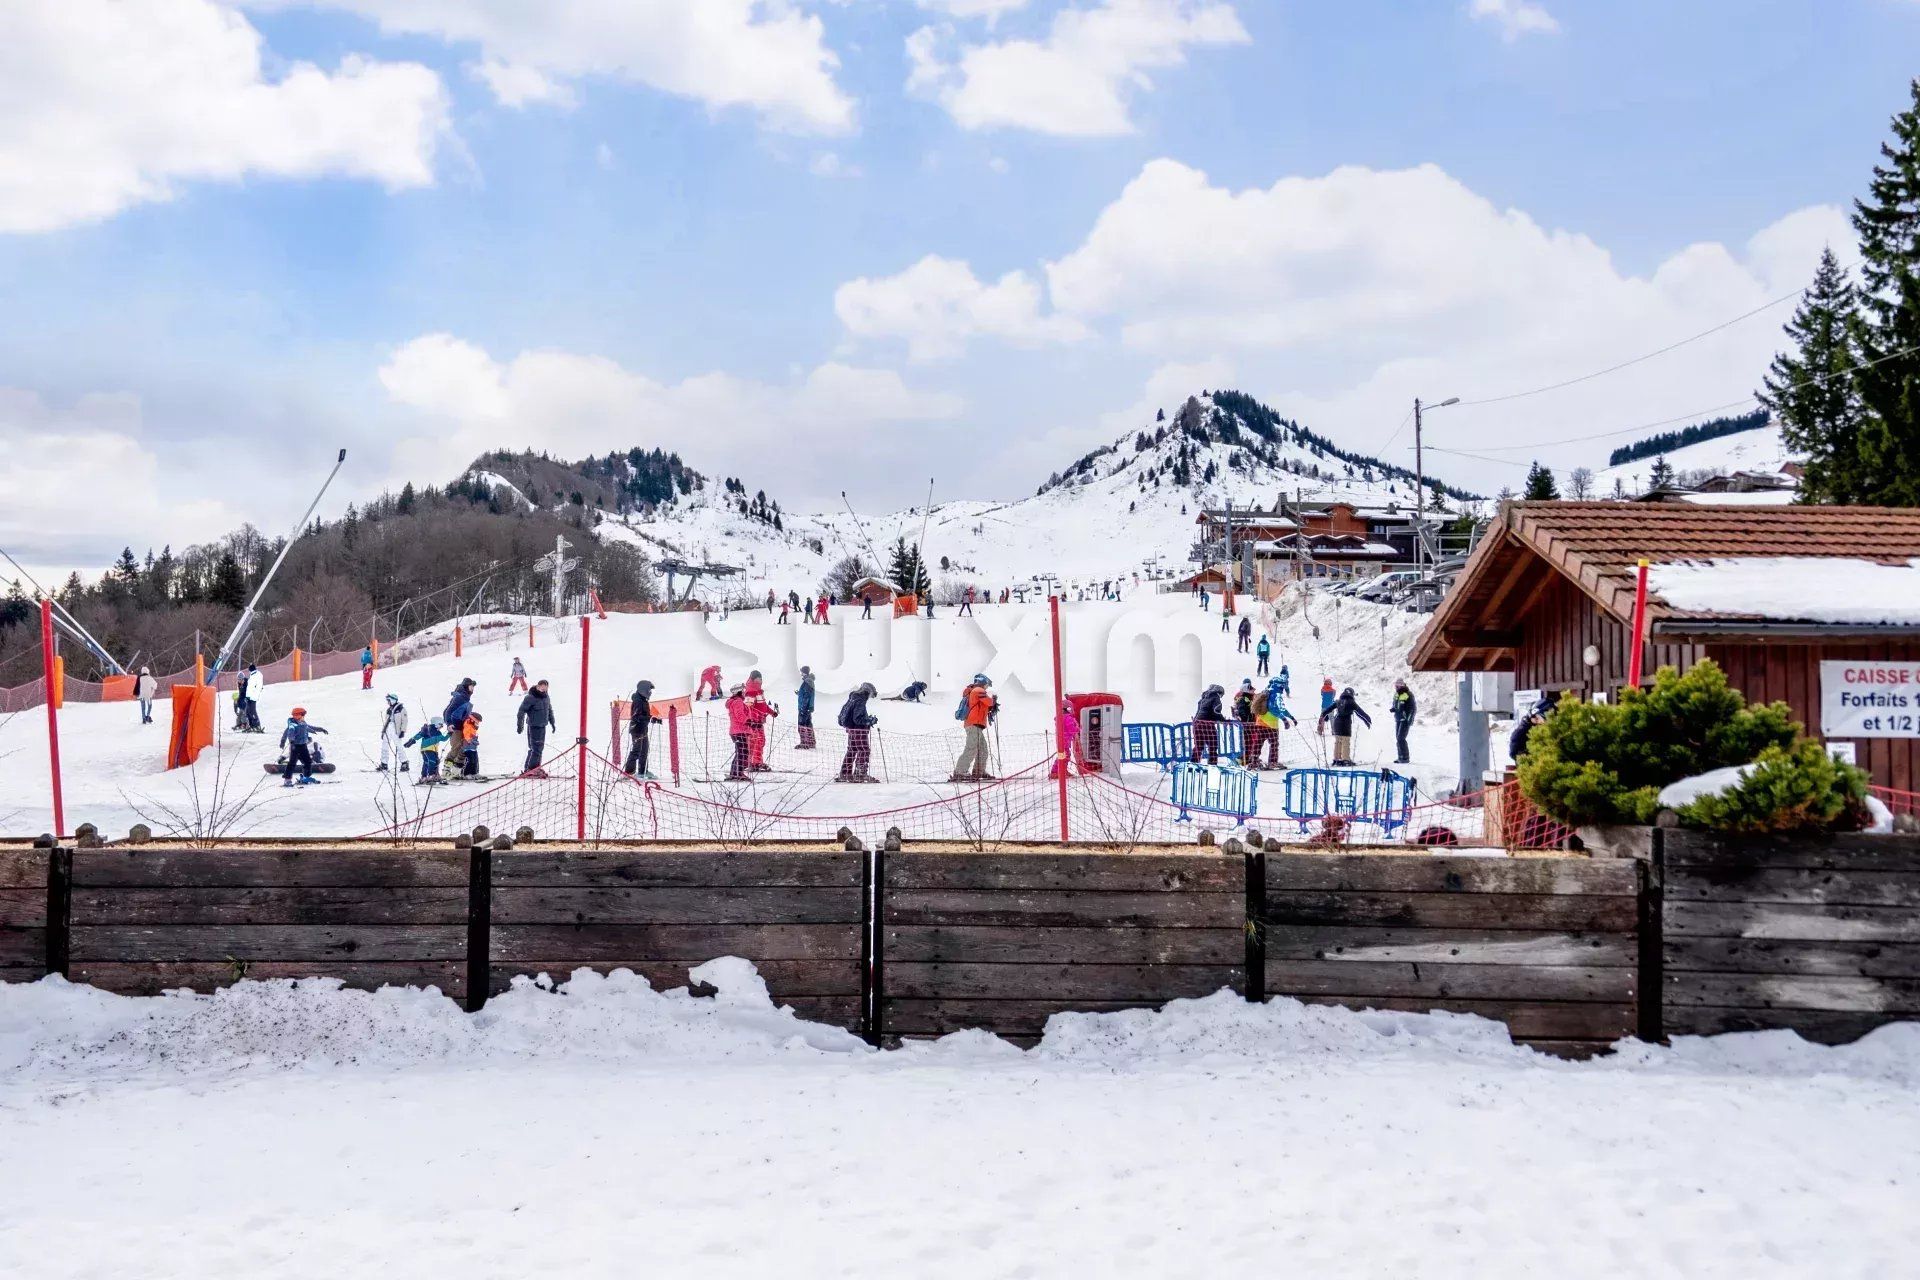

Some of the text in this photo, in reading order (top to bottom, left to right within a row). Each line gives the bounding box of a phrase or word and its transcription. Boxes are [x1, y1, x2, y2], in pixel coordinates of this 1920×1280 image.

[1844, 668, 1910, 684] CAISSE
[1841, 692, 1908, 707] Forfaits
[1863, 716, 1881, 730] et
[1887, 715, 1912, 731] 1/2
